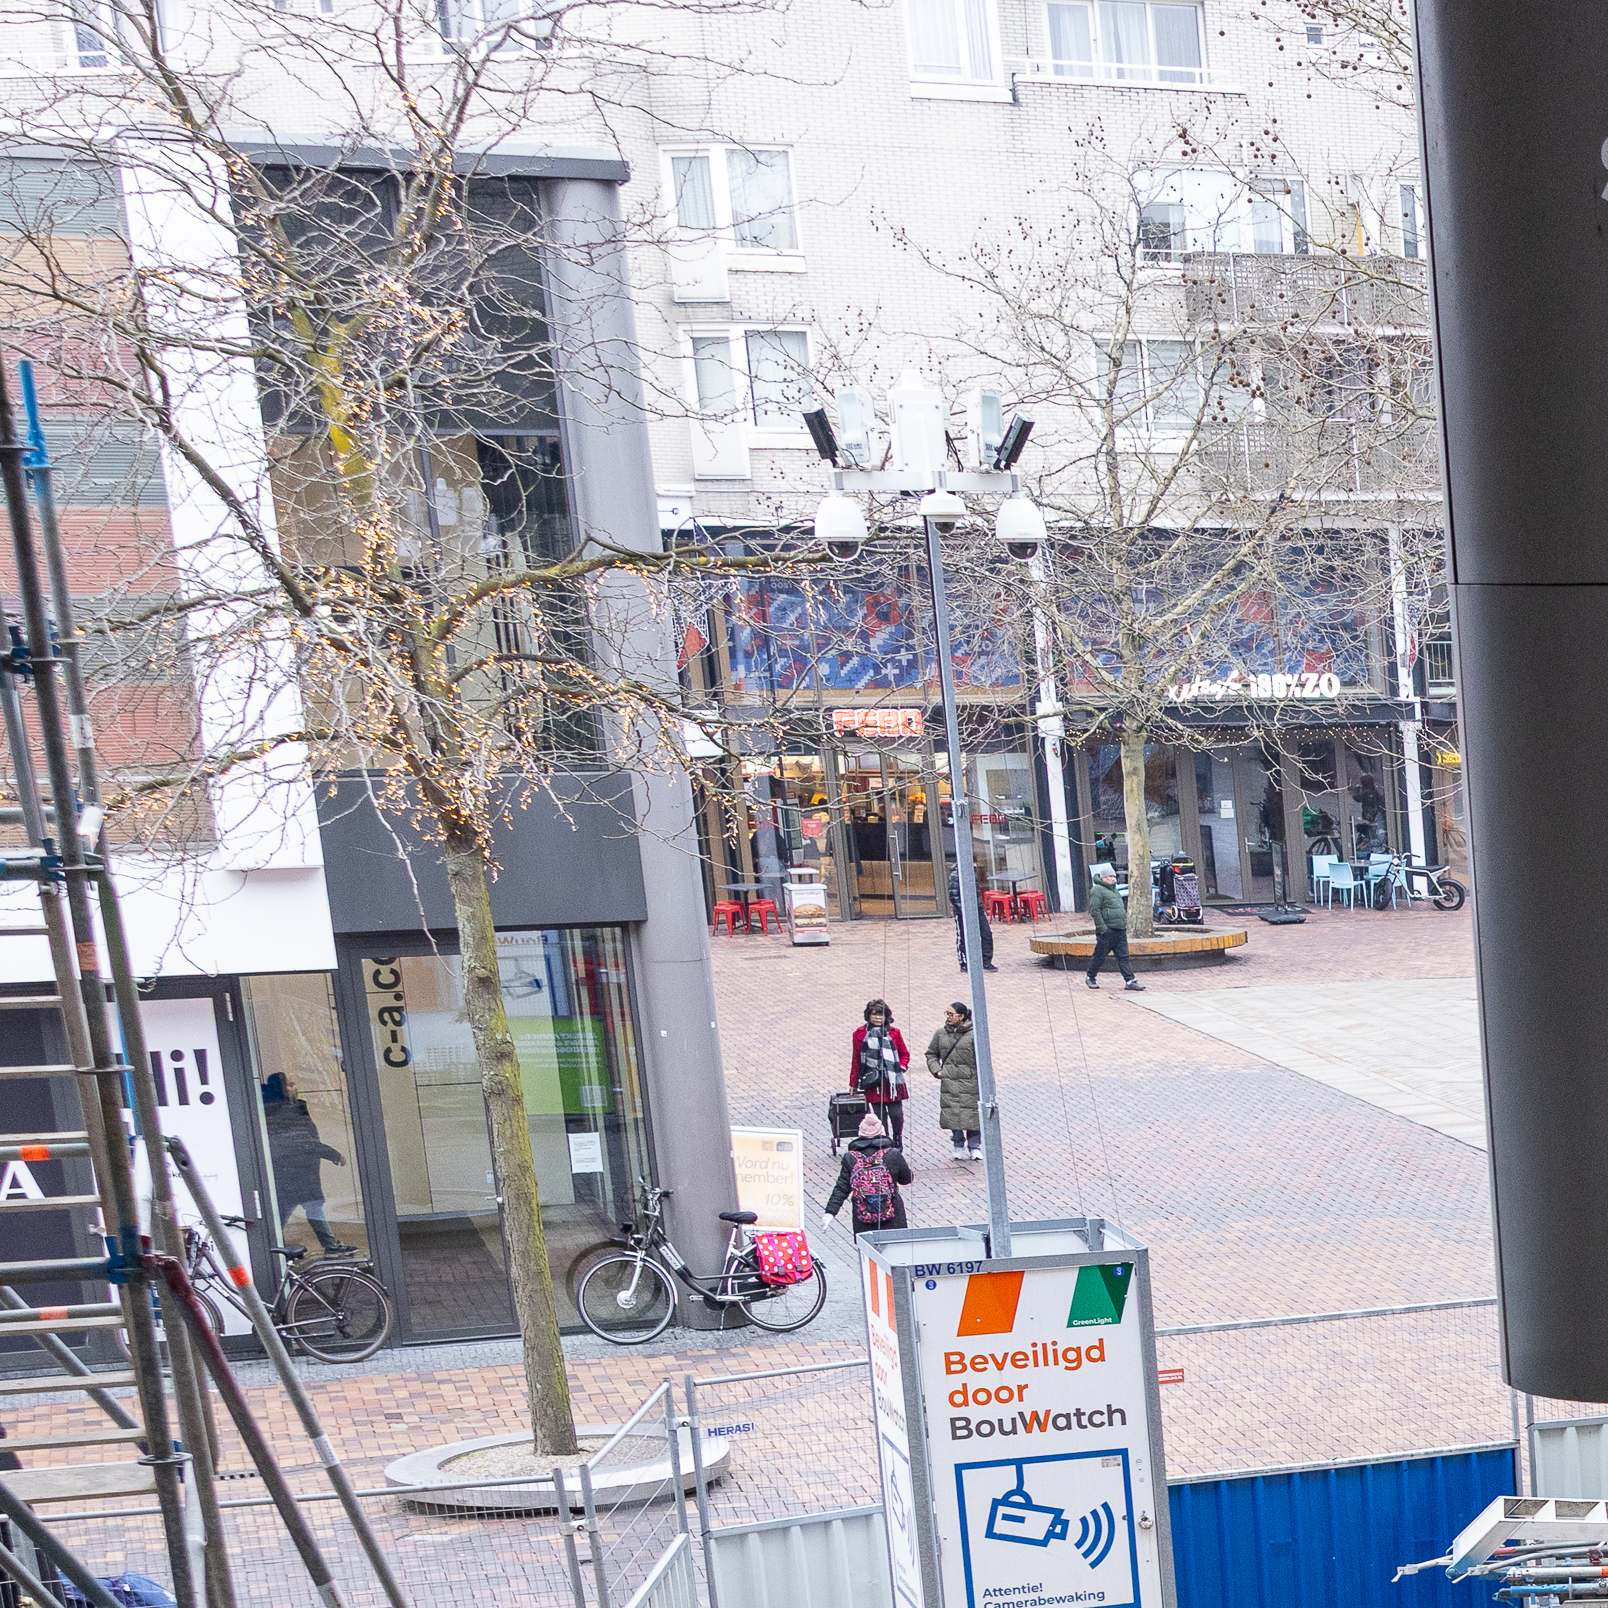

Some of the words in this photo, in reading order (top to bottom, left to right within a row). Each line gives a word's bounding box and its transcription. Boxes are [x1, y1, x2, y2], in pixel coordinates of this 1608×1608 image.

[833, 709, 923, 737] FEBO
[772, 1160, 790, 1170] nu
[766, 1193, 794, 1207] 10%
[914, 1263, 942, 1277] BW
[947, 1261, 983, 1274] 6197
[1072, 1317, 1113, 1326] GreenLight
[944, 1338, 1106, 1376] Beveiligd
[948, 1383, 1029, 1408] door
[950, 1404, 1127, 1440] BouWatch
[982, 1583, 1043, 1598] Attentie!
